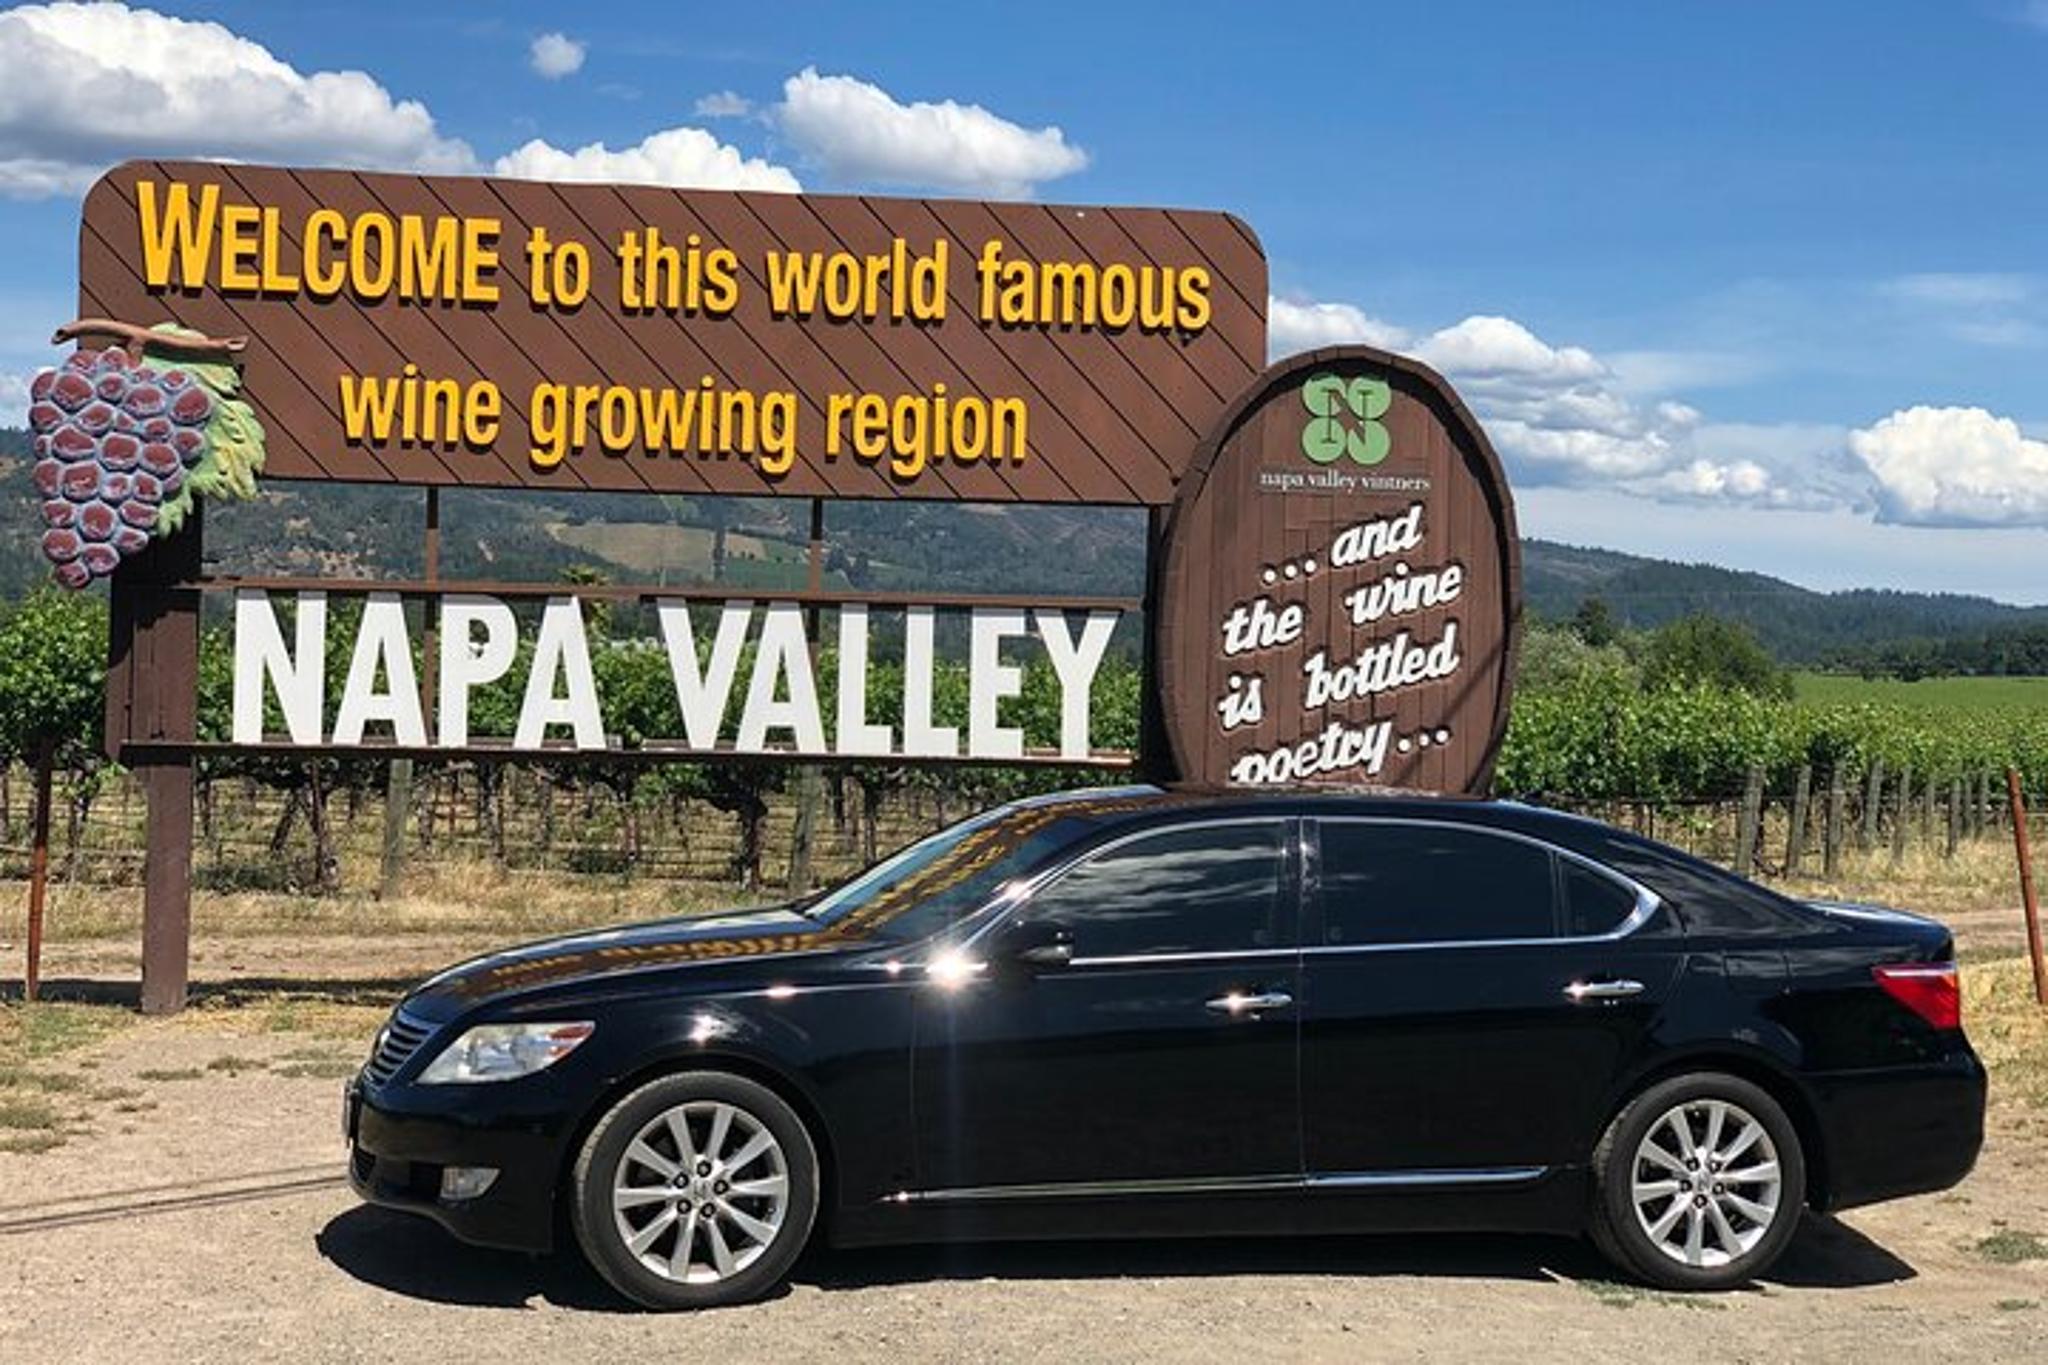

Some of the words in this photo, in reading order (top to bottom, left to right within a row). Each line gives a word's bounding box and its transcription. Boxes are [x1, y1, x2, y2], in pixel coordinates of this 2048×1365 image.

[137, 181, 500, 300] WELCOME
[527, 226, 590, 306] to
[619, 226, 738, 312] this
[767, 237, 948, 320] world
[978, 241, 1212, 330] famous
[340, 363, 499, 446] wine
[530, 376, 796, 475] growing
[826, 383, 1027, 477] region
[1260, 471, 1303, 491] napa
[1307, 469, 1357, 493] valley
[1222, 599, 1303, 655] the
[1345, 562, 1462, 624] wine
[232, 587, 606, 751] NAPA
[656, 597, 1122, 760] VALLEY
[1218, 676, 1263, 729] is
[1305, 623, 1460, 709] bottled
